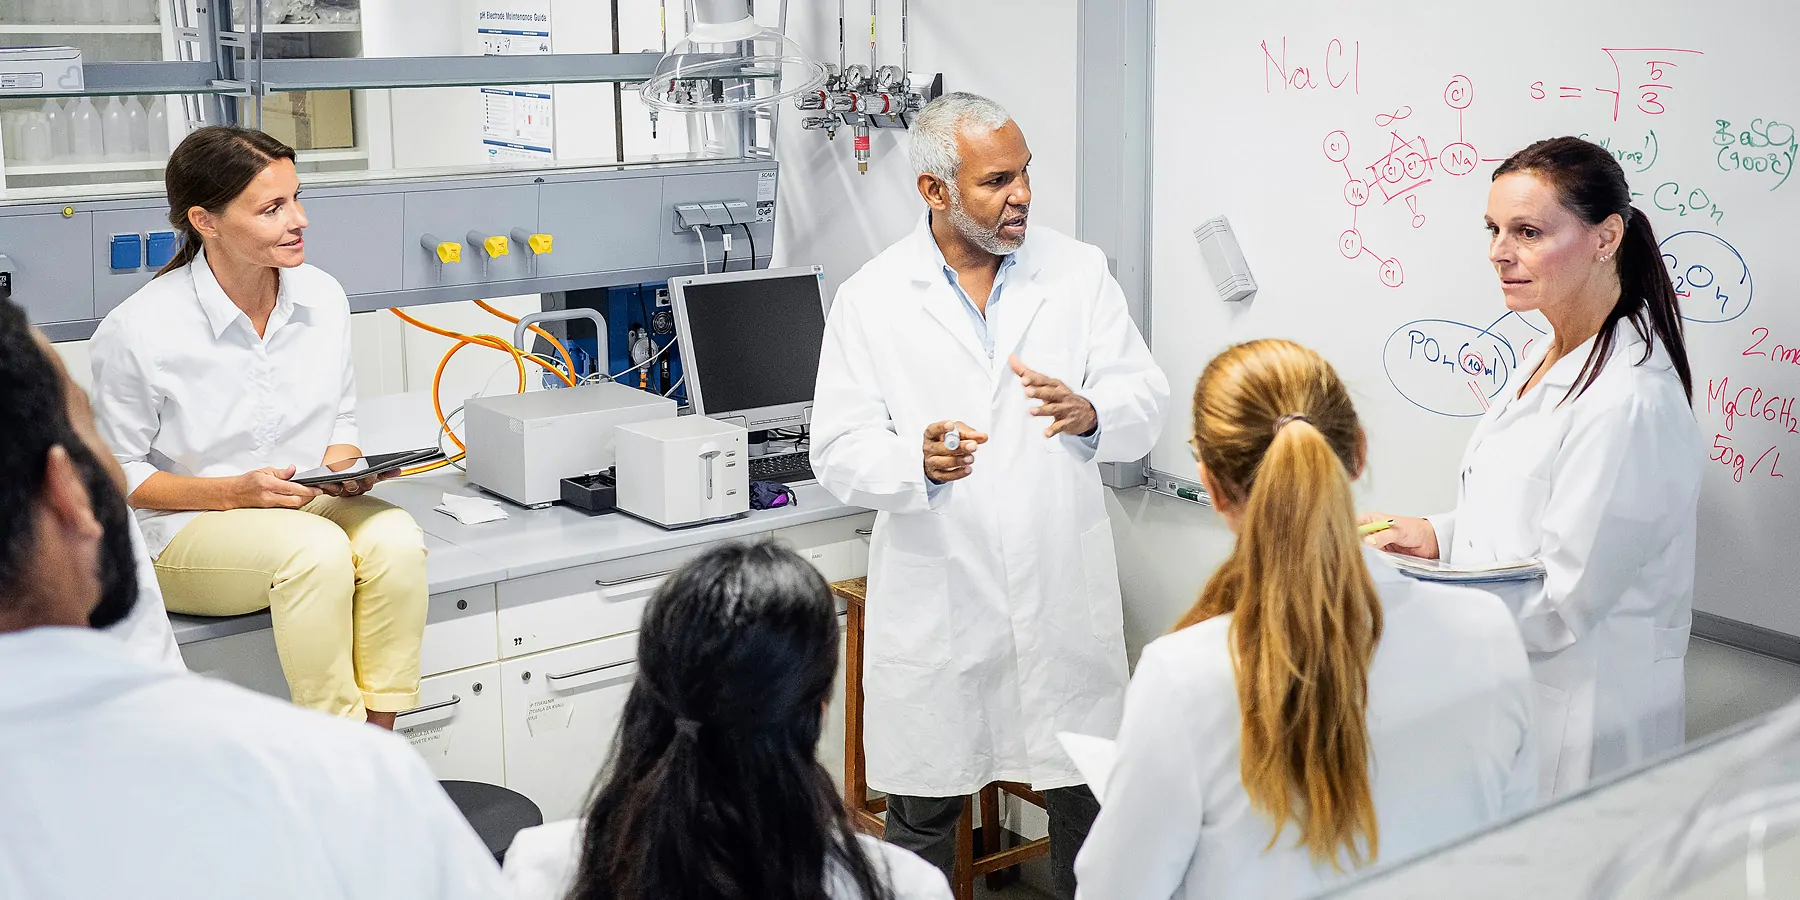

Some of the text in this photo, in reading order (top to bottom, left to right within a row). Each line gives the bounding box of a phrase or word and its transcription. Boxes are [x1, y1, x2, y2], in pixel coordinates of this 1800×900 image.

[487, 11, 505, 20] Electrode
[506, 12, 533, 21] Maintenance
[534, 13, 547, 22] Guide
[1637, 91, 1666, 115] 3
[1451, 150, 1473, 168] Na
[1351, 187, 1365, 200] Na
[1742, 327, 1769, 356] 2
